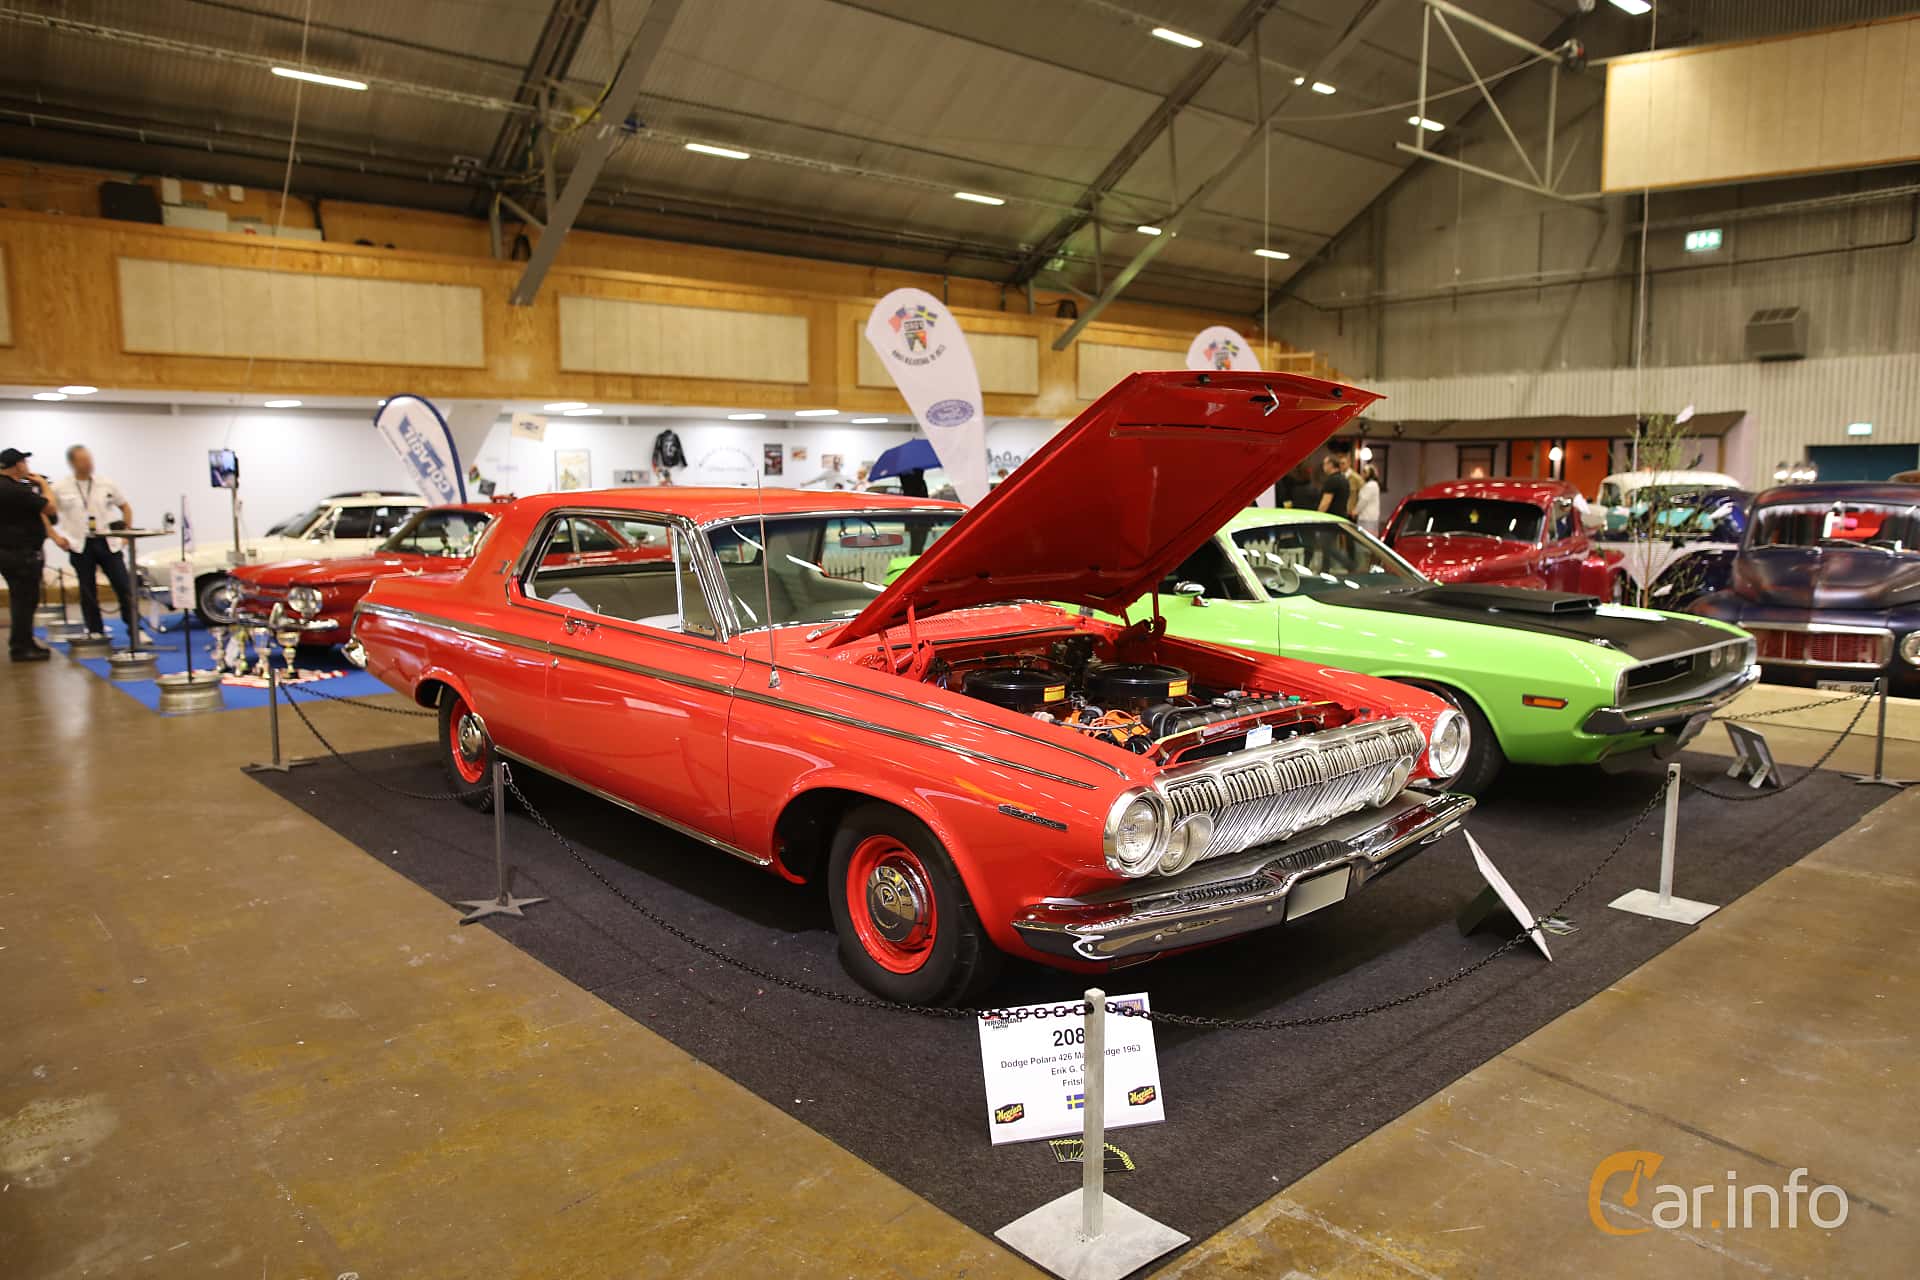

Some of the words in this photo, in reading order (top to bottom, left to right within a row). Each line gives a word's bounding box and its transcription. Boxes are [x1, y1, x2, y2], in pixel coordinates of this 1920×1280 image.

[1052, 1027, 1085, 1047] 208
[1001, 1059, 1028, 1069] Dodge
[1030, 1055, 1057, 1065] Polara
[1059, 1052, 1073, 1061] 426
[1123, 1044, 1141, 1053] 1963
[1051, 1065, 1068, 1076] Erik
[1062, 1078, 1084, 1088] Fritsl
